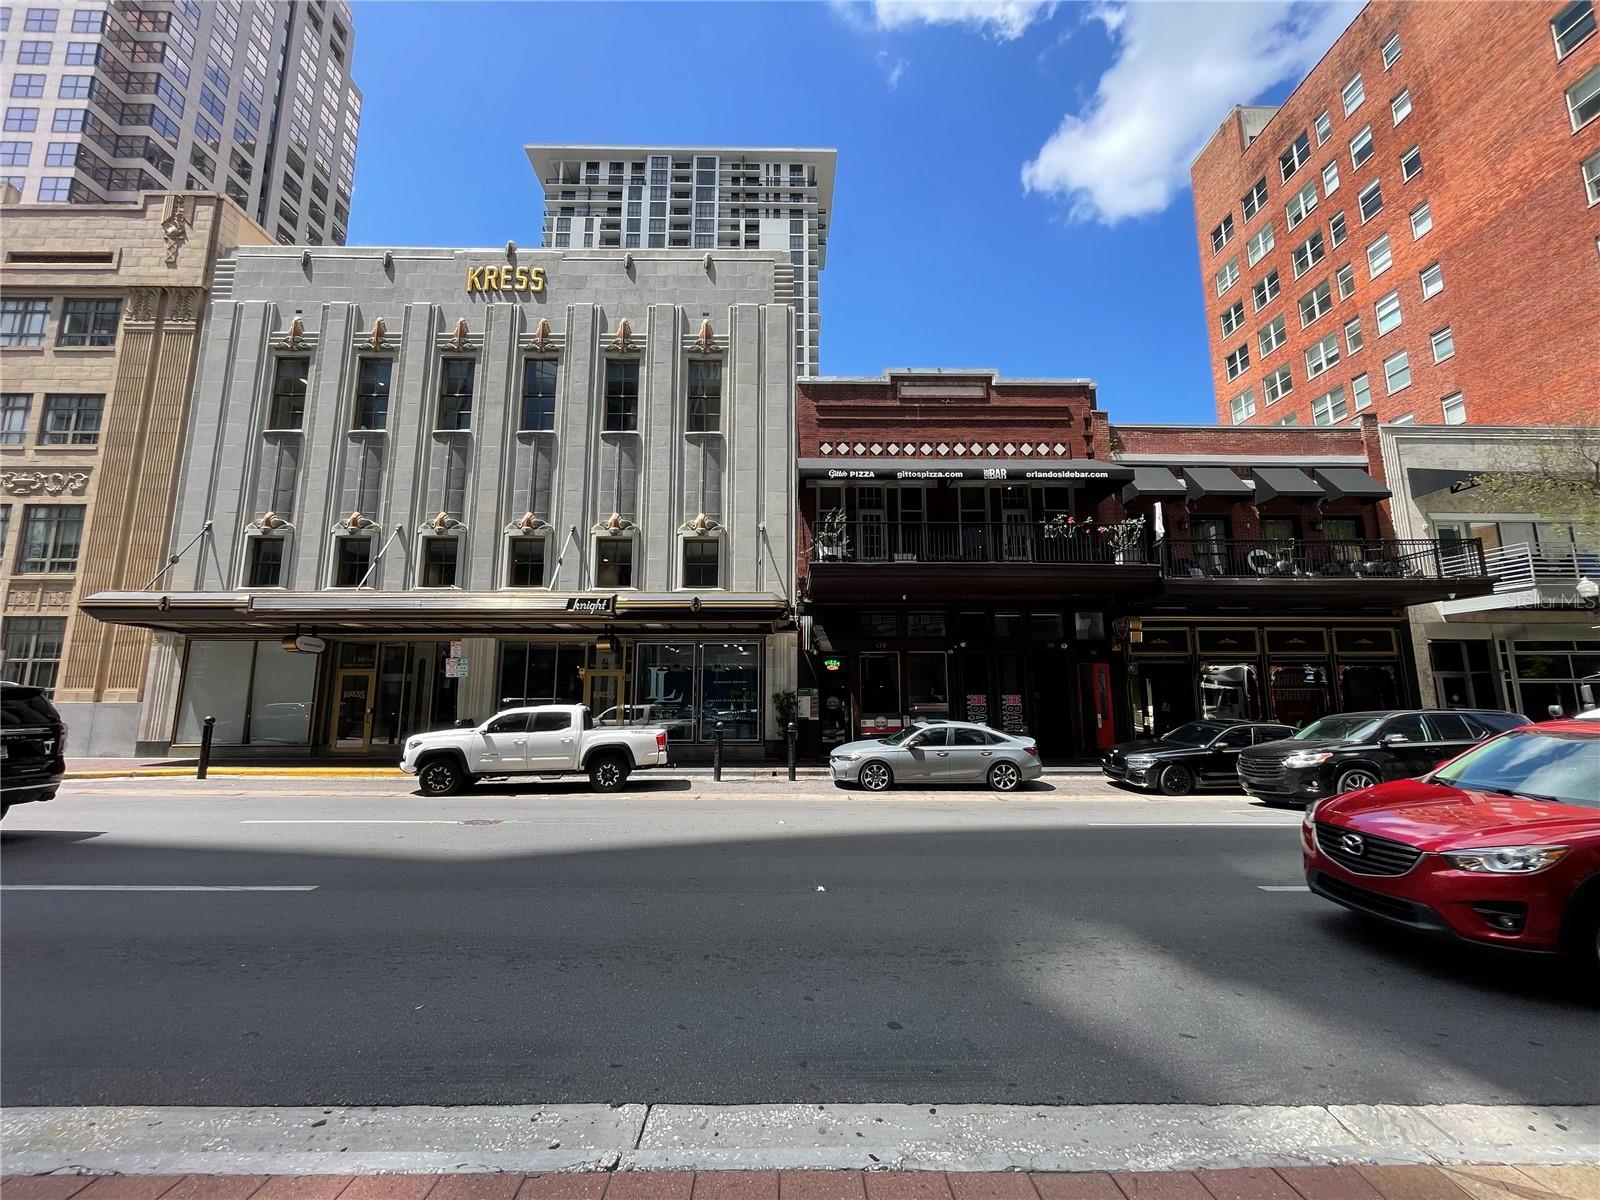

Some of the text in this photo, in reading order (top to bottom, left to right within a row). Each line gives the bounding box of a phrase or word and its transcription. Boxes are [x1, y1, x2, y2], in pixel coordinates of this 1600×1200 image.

[466, 265, 545, 292] KRESS
[897, 470, 963, 479] gittospizza.com
[990, 468, 1007, 480] BAR
[1026, 470, 1109, 479] orlandosidebar.com
[573, 598, 607, 614] knight
